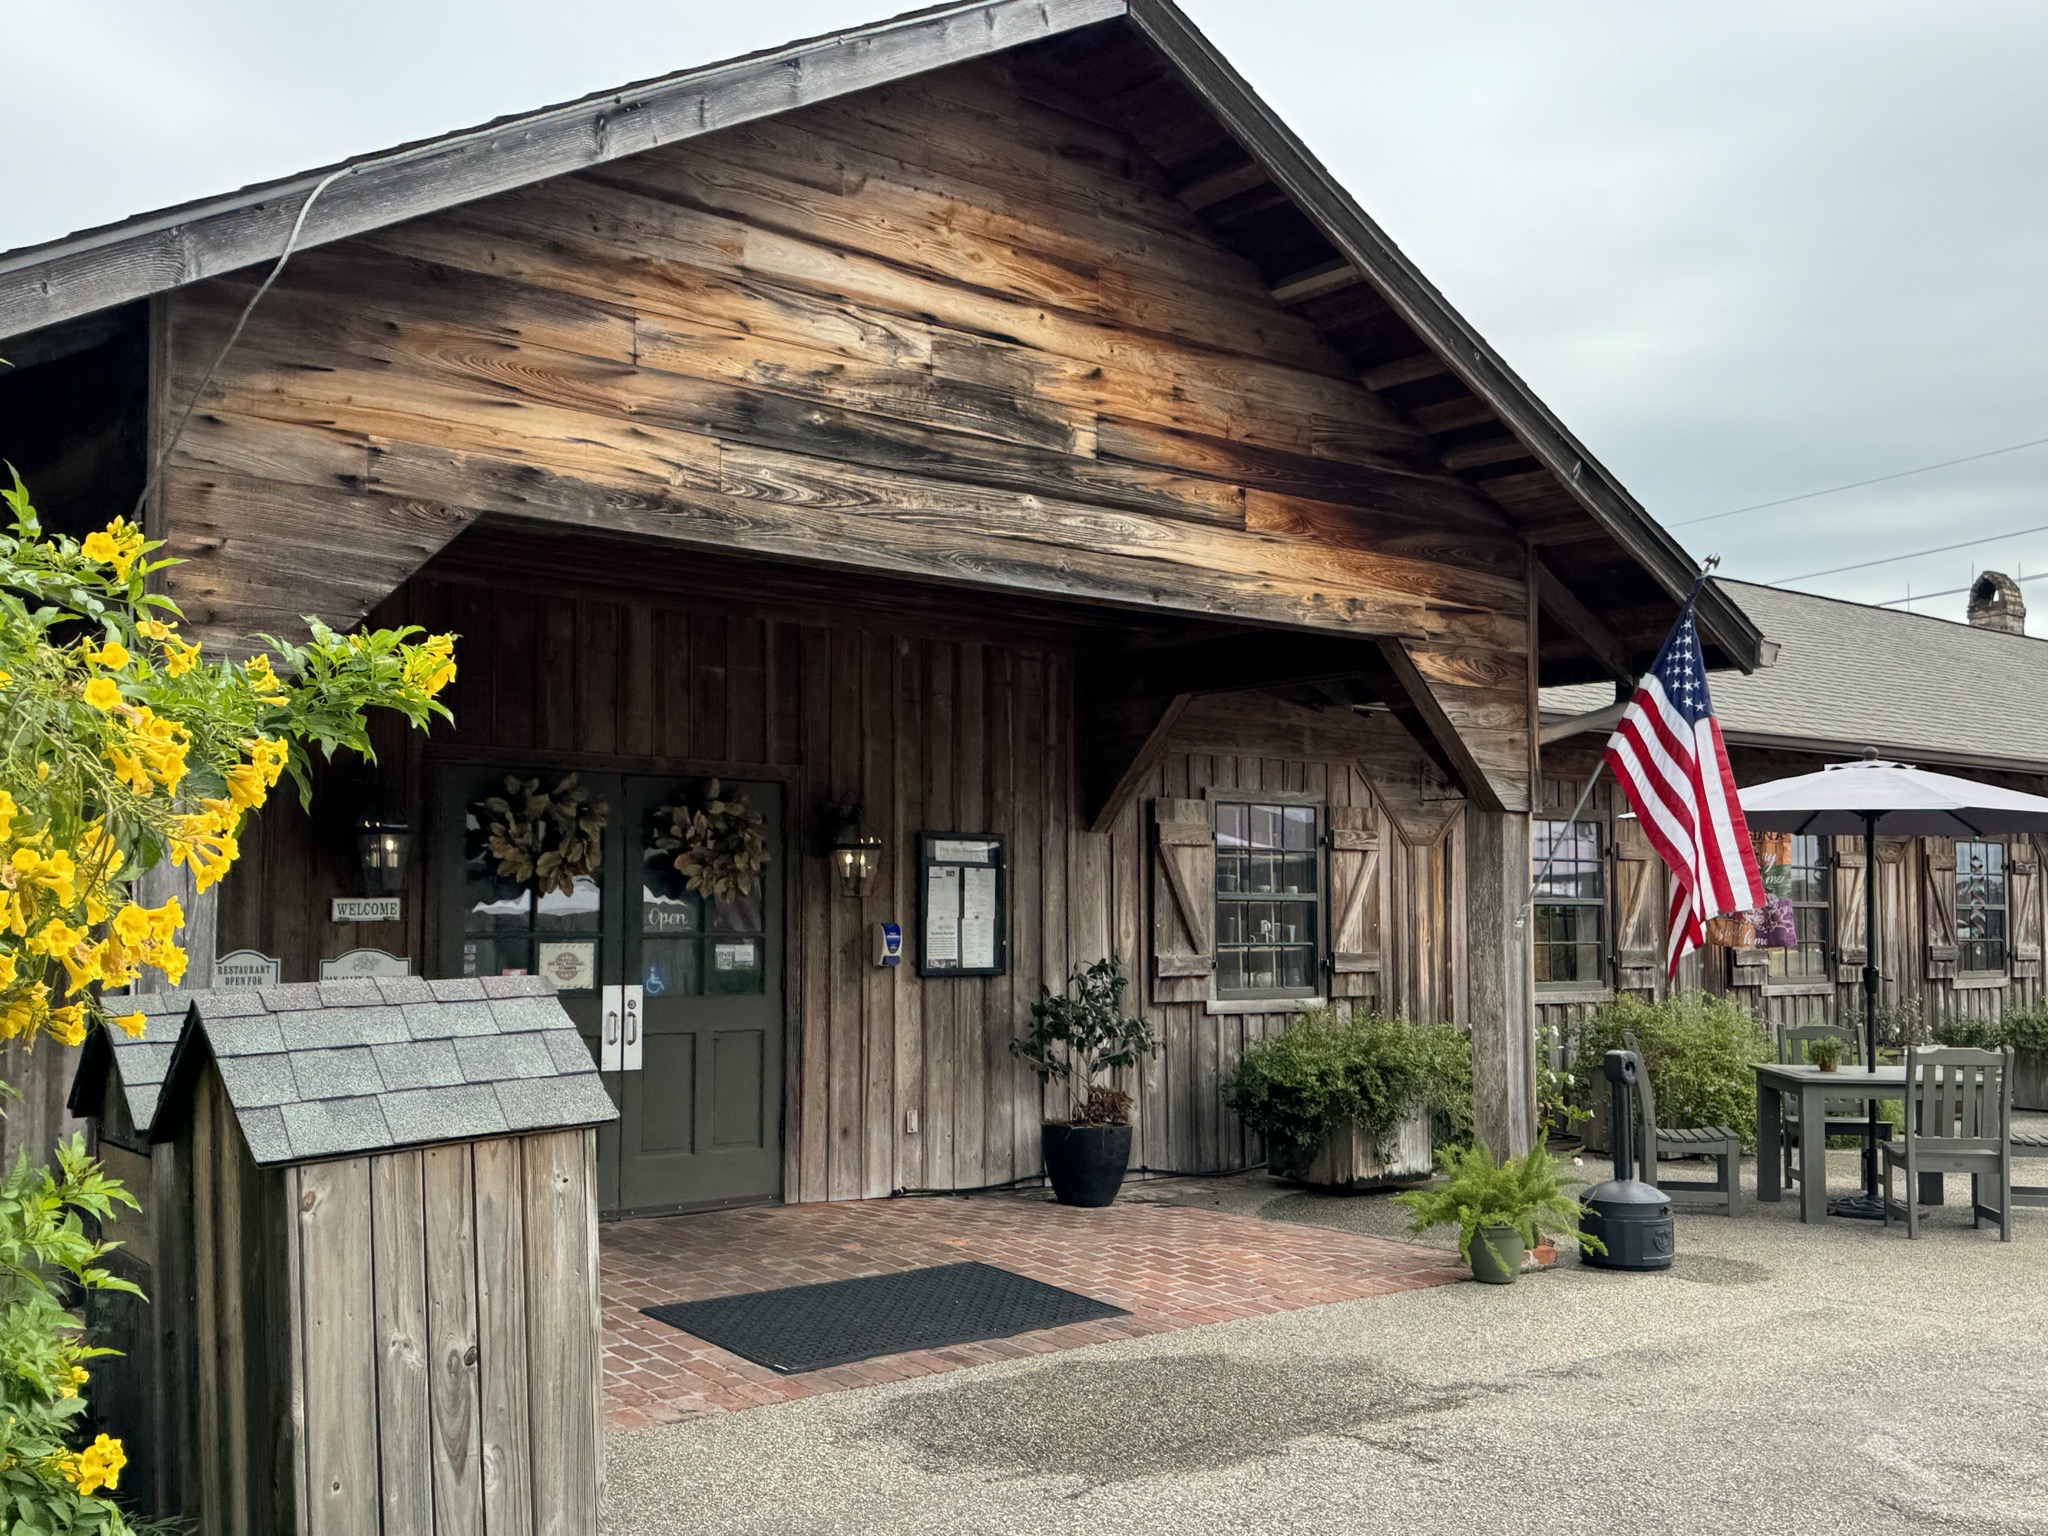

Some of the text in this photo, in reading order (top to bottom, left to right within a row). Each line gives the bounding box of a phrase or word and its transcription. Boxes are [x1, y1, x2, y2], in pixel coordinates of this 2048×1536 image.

[336, 902, 398, 916] WELCOME
[648, 907, 688, 931] Open
[217, 964, 271, 975] RESTAURANT
[225, 976, 262, 986] OPEN FOR
